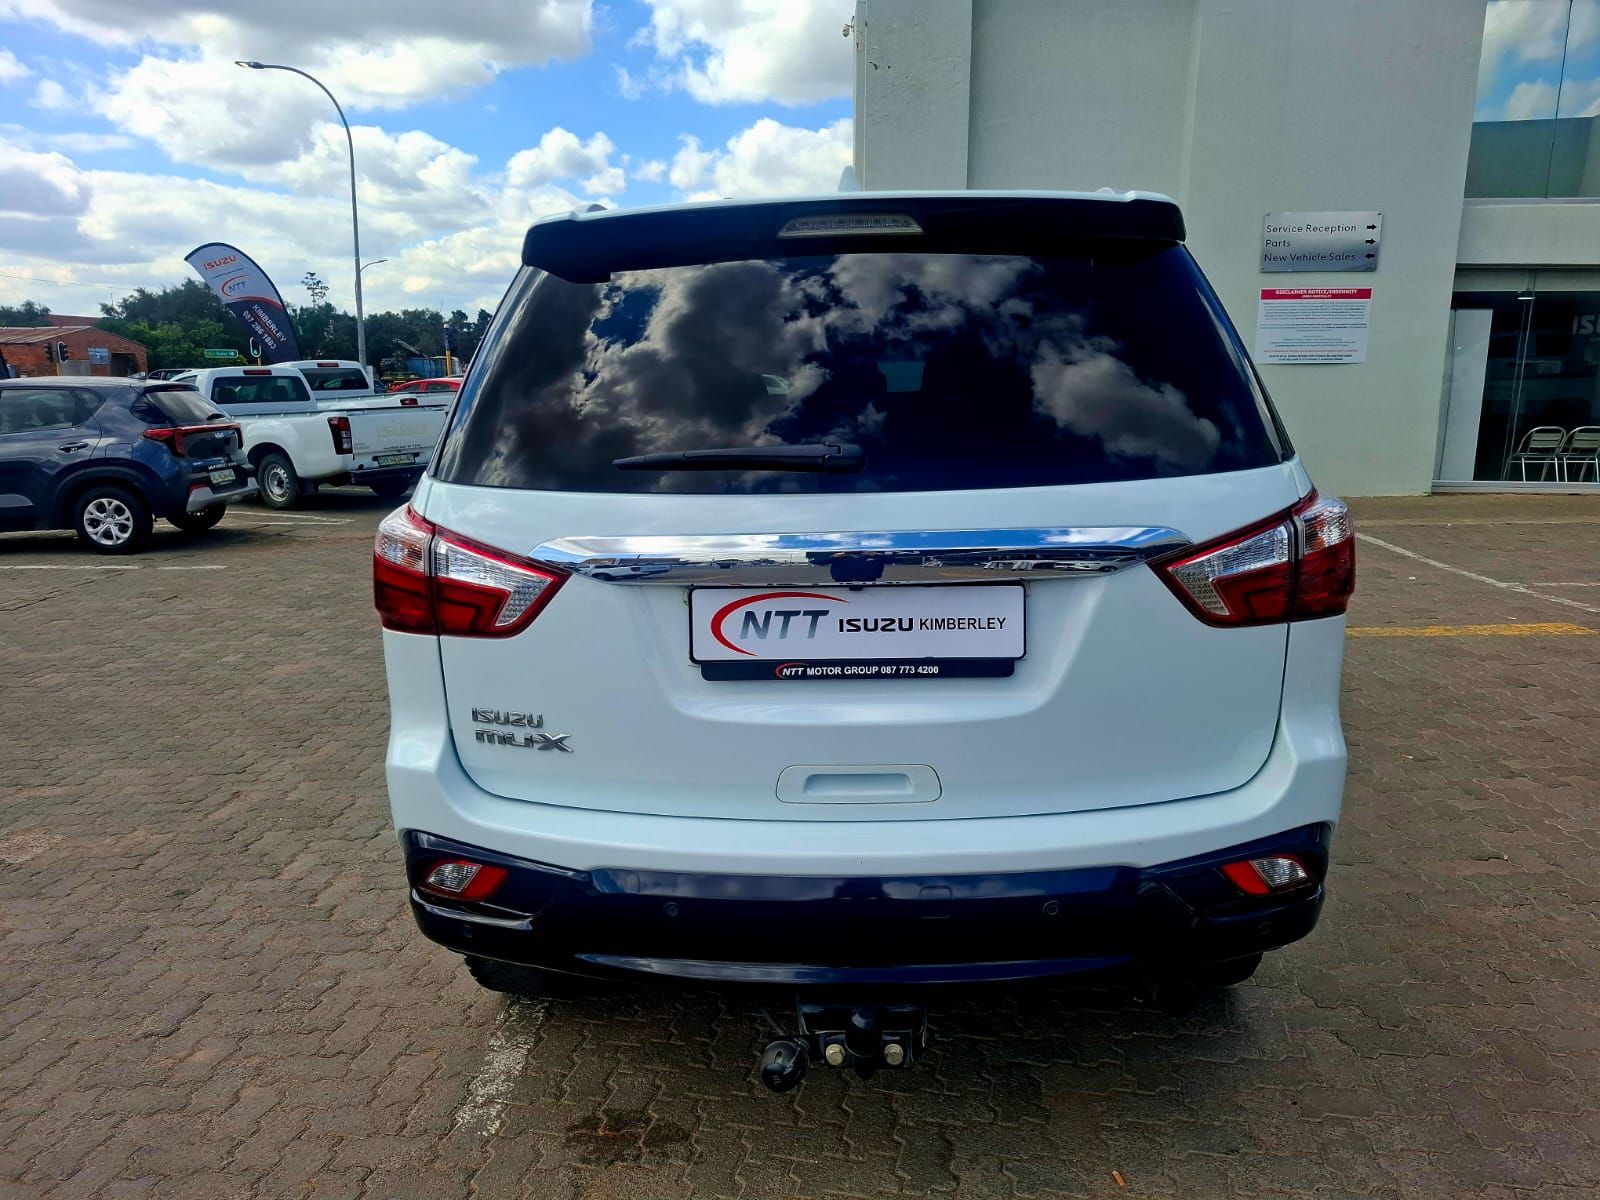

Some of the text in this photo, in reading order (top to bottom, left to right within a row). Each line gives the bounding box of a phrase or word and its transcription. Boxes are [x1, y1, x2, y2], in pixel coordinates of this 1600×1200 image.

[1266, 224, 1357, 234] Service Reception
[1265, 239, 1291, 248] Parts
[203, 255, 237, 270] ISUZU
[1264, 252, 1356, 262] New Vehicle Sales
[228, 281, 247, 294] NTT
[252, 304, 287, 342] KIMBERLEY
[1572, 314, 1600, 335] IS
[739, 609, 1006, 640] NTT ISUZU KIMBERLEY
[781, 665, 939, 677] NTT MOTOR GROUP 087 773 4200
[471, 707, 544, 729] ISUZU
